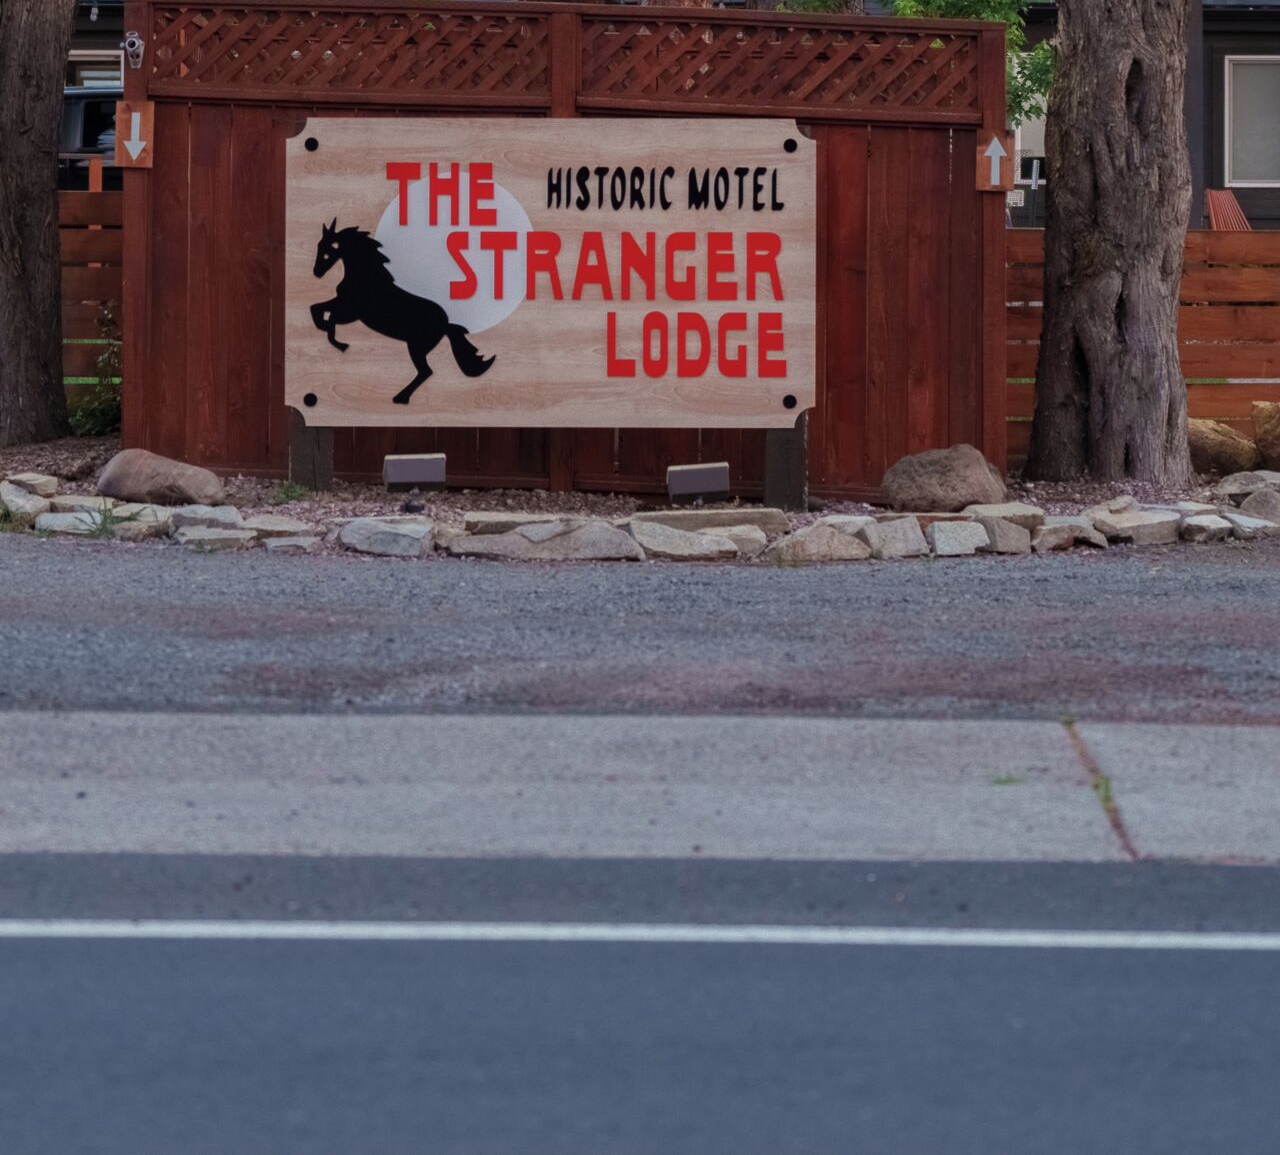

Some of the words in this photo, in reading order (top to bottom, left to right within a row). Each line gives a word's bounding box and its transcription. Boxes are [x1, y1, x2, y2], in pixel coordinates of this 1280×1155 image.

[386, 161, 497, 226] THE
[547, 166, 676, 211] HISTORIC
[688, 166, 784, 212] MOTEL
[446, 231, 784, 302] STRANGER
[606, 311, 787, 379] LODGE
